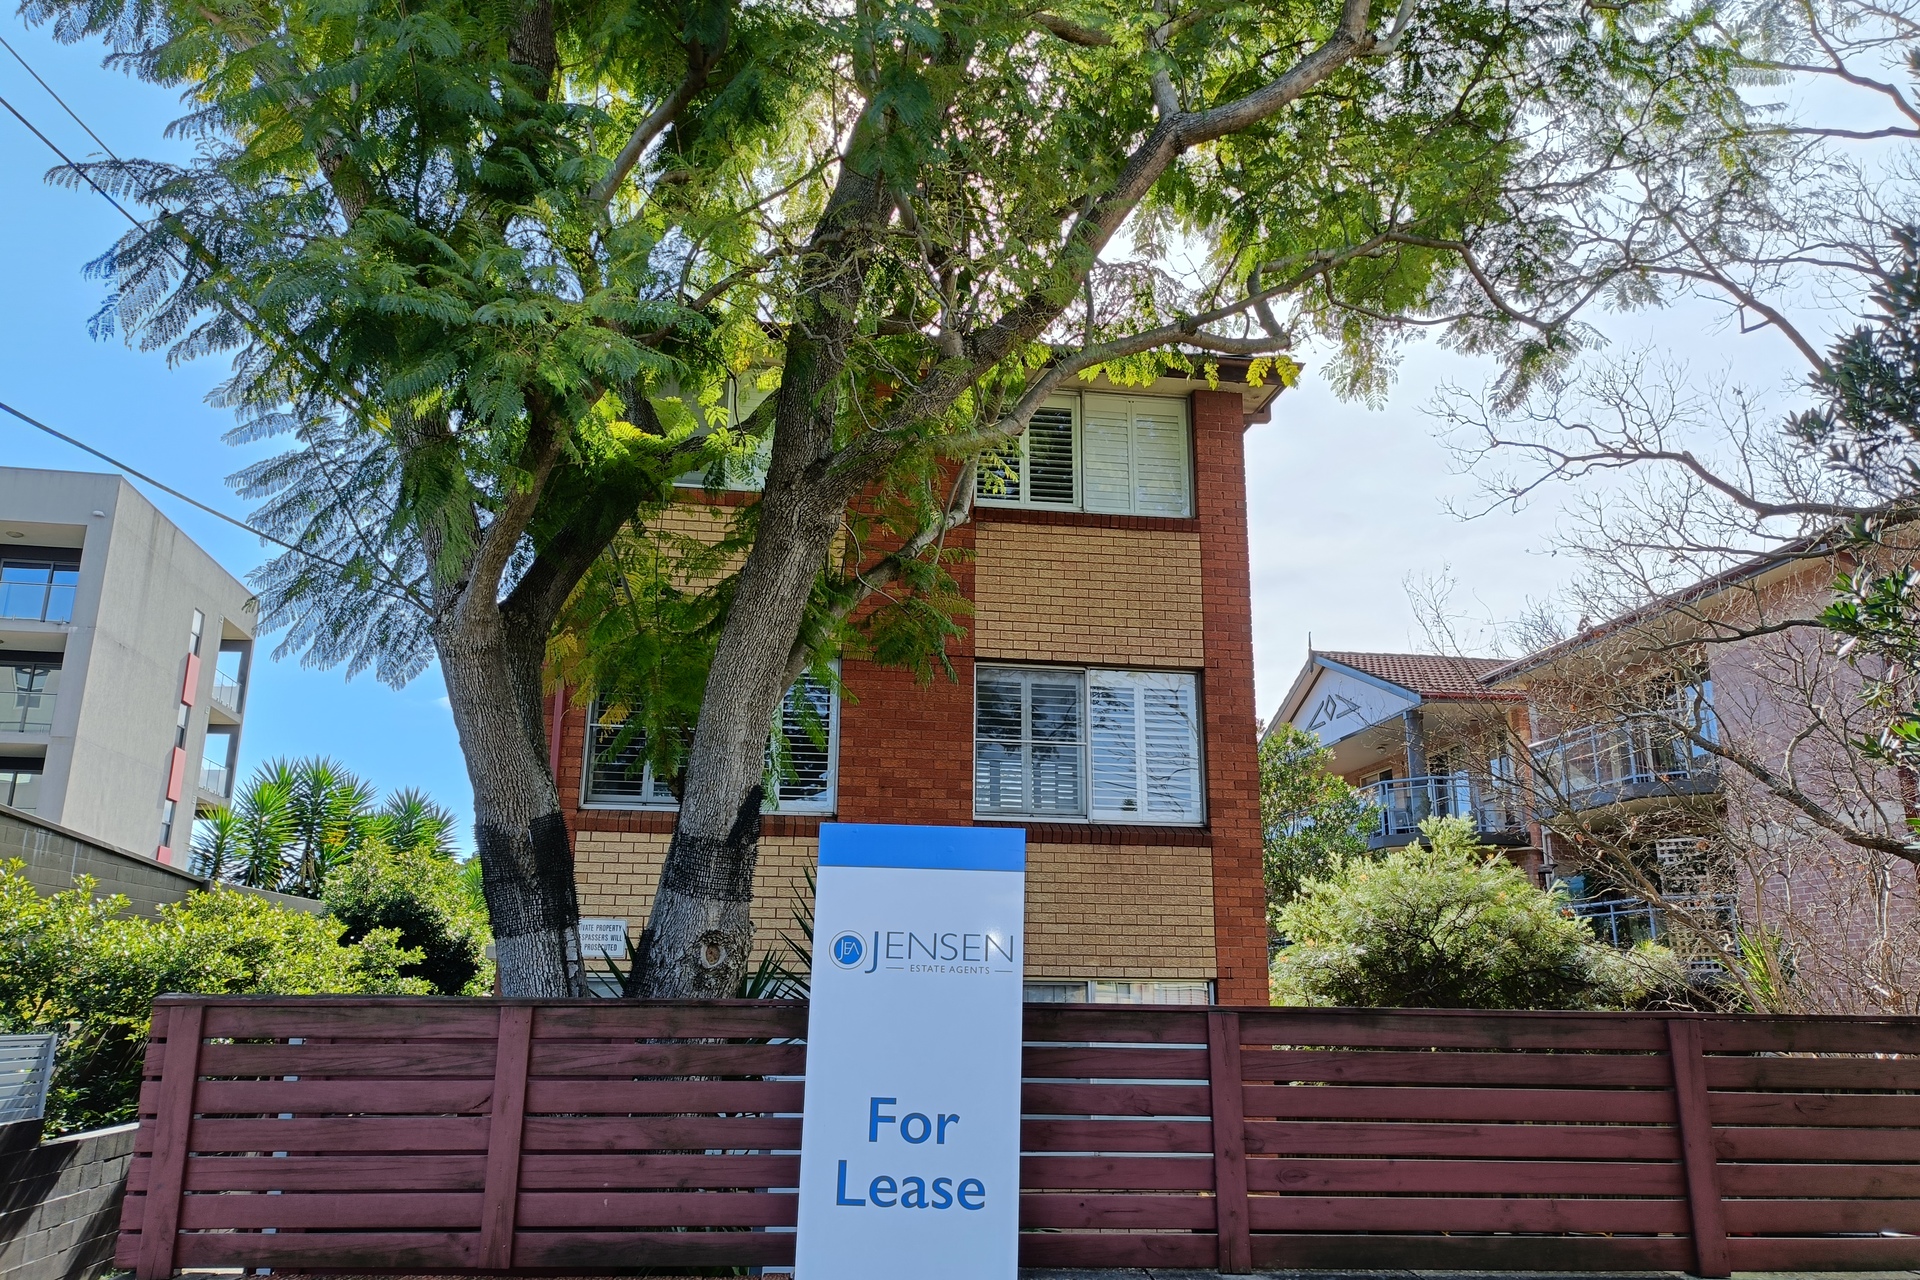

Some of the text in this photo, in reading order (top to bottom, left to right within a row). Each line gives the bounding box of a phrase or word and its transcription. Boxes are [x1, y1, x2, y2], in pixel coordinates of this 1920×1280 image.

[580, 924, 622, 932] IVATE PROPERTY
[580, 933, 609, 941] SPASSERS
[864, 930, 1014, 974] JENSEN
[909, 964, 991, 975] ESTATE AGENTS
[868, 1096, 961, 1145] For
[836, 1159, 986, 1211] Lease
